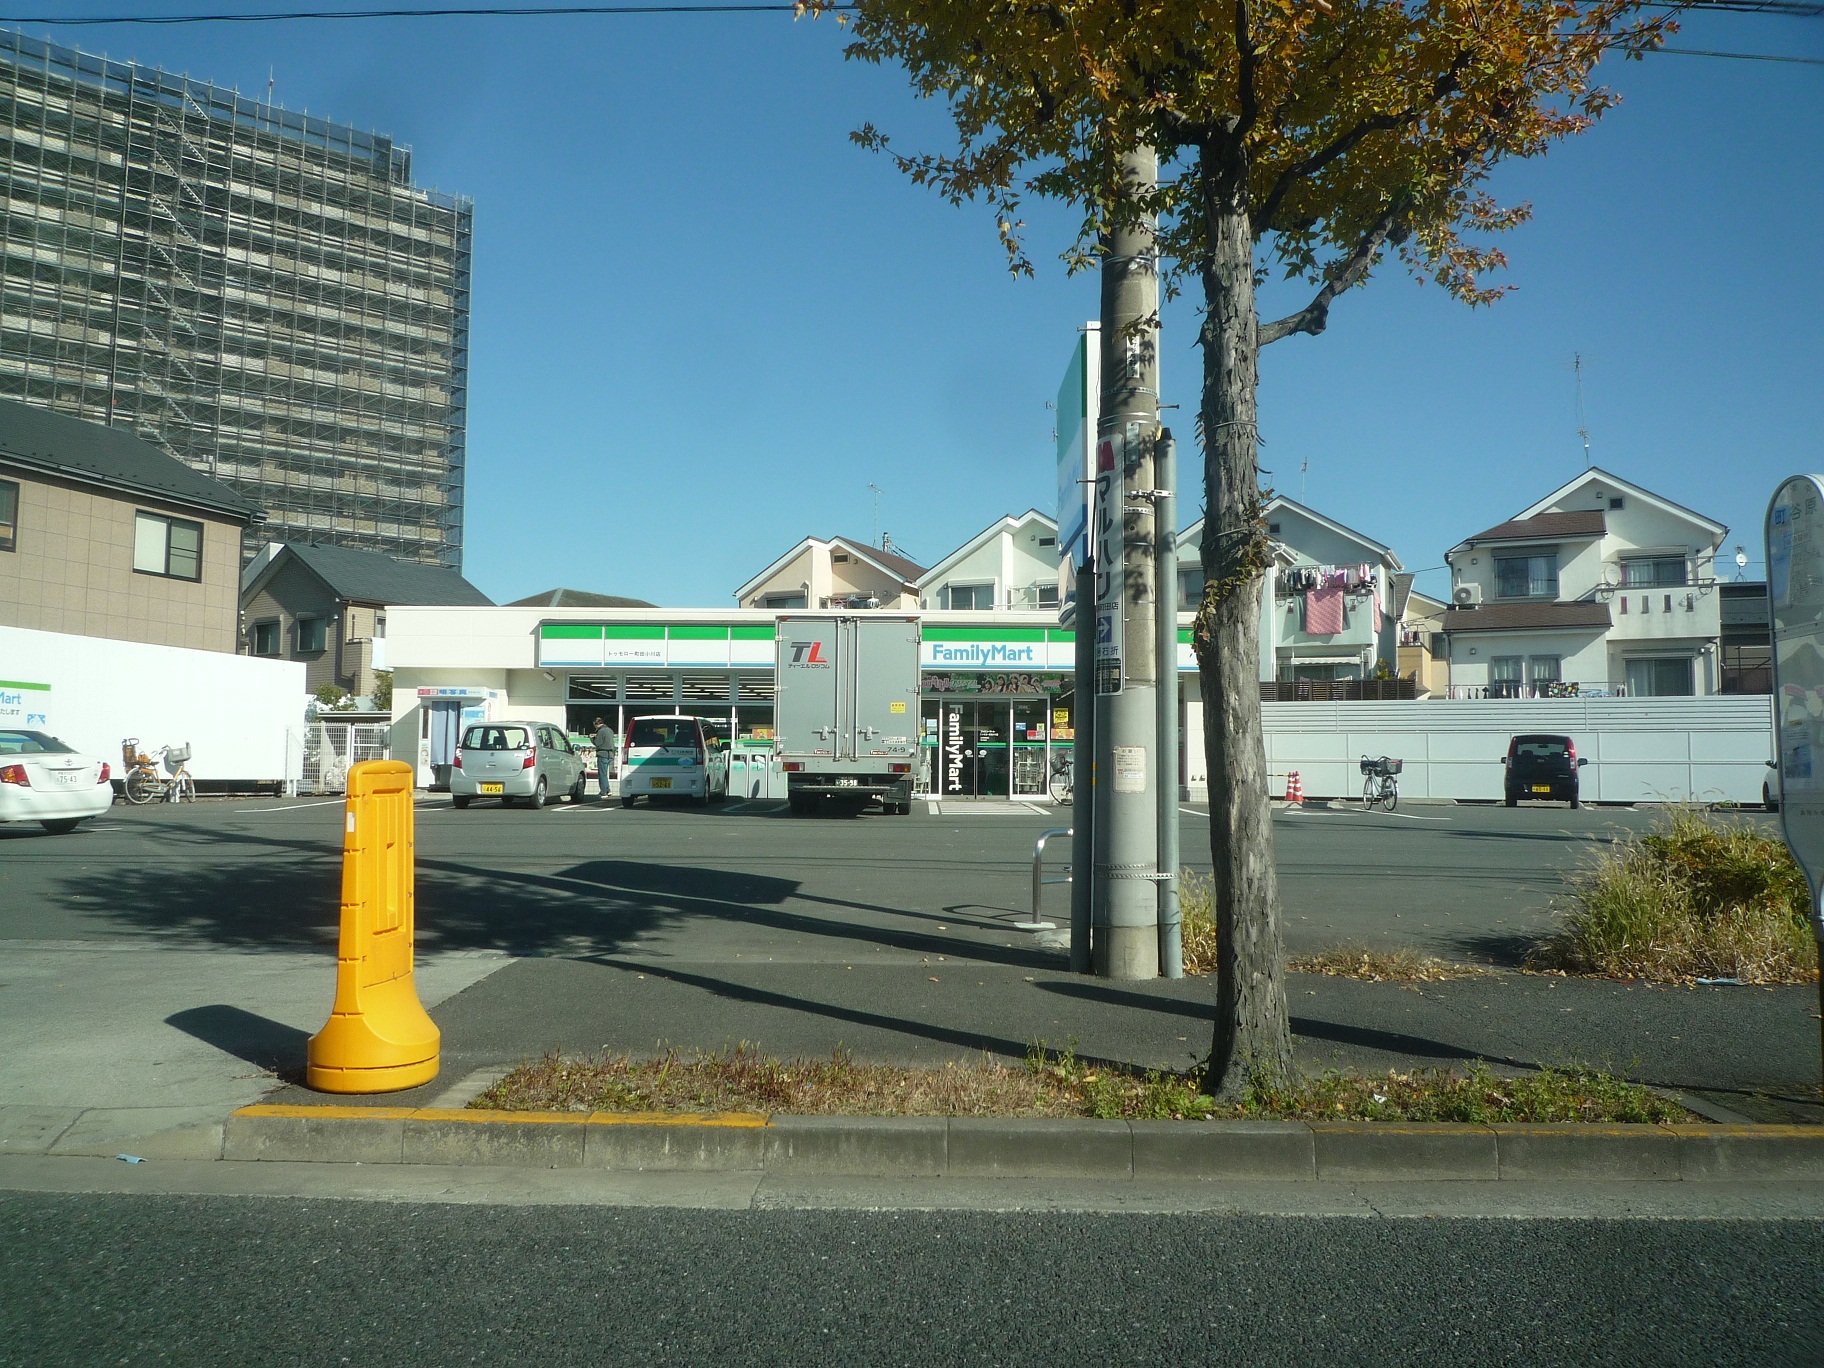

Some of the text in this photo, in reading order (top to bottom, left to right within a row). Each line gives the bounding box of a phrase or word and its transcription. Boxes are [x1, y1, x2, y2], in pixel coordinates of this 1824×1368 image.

[790, 641, 828, 663] TL
[932, 643, 1033, 666] FamilyMart
[945, 704, 963, 791] FamilyMart
